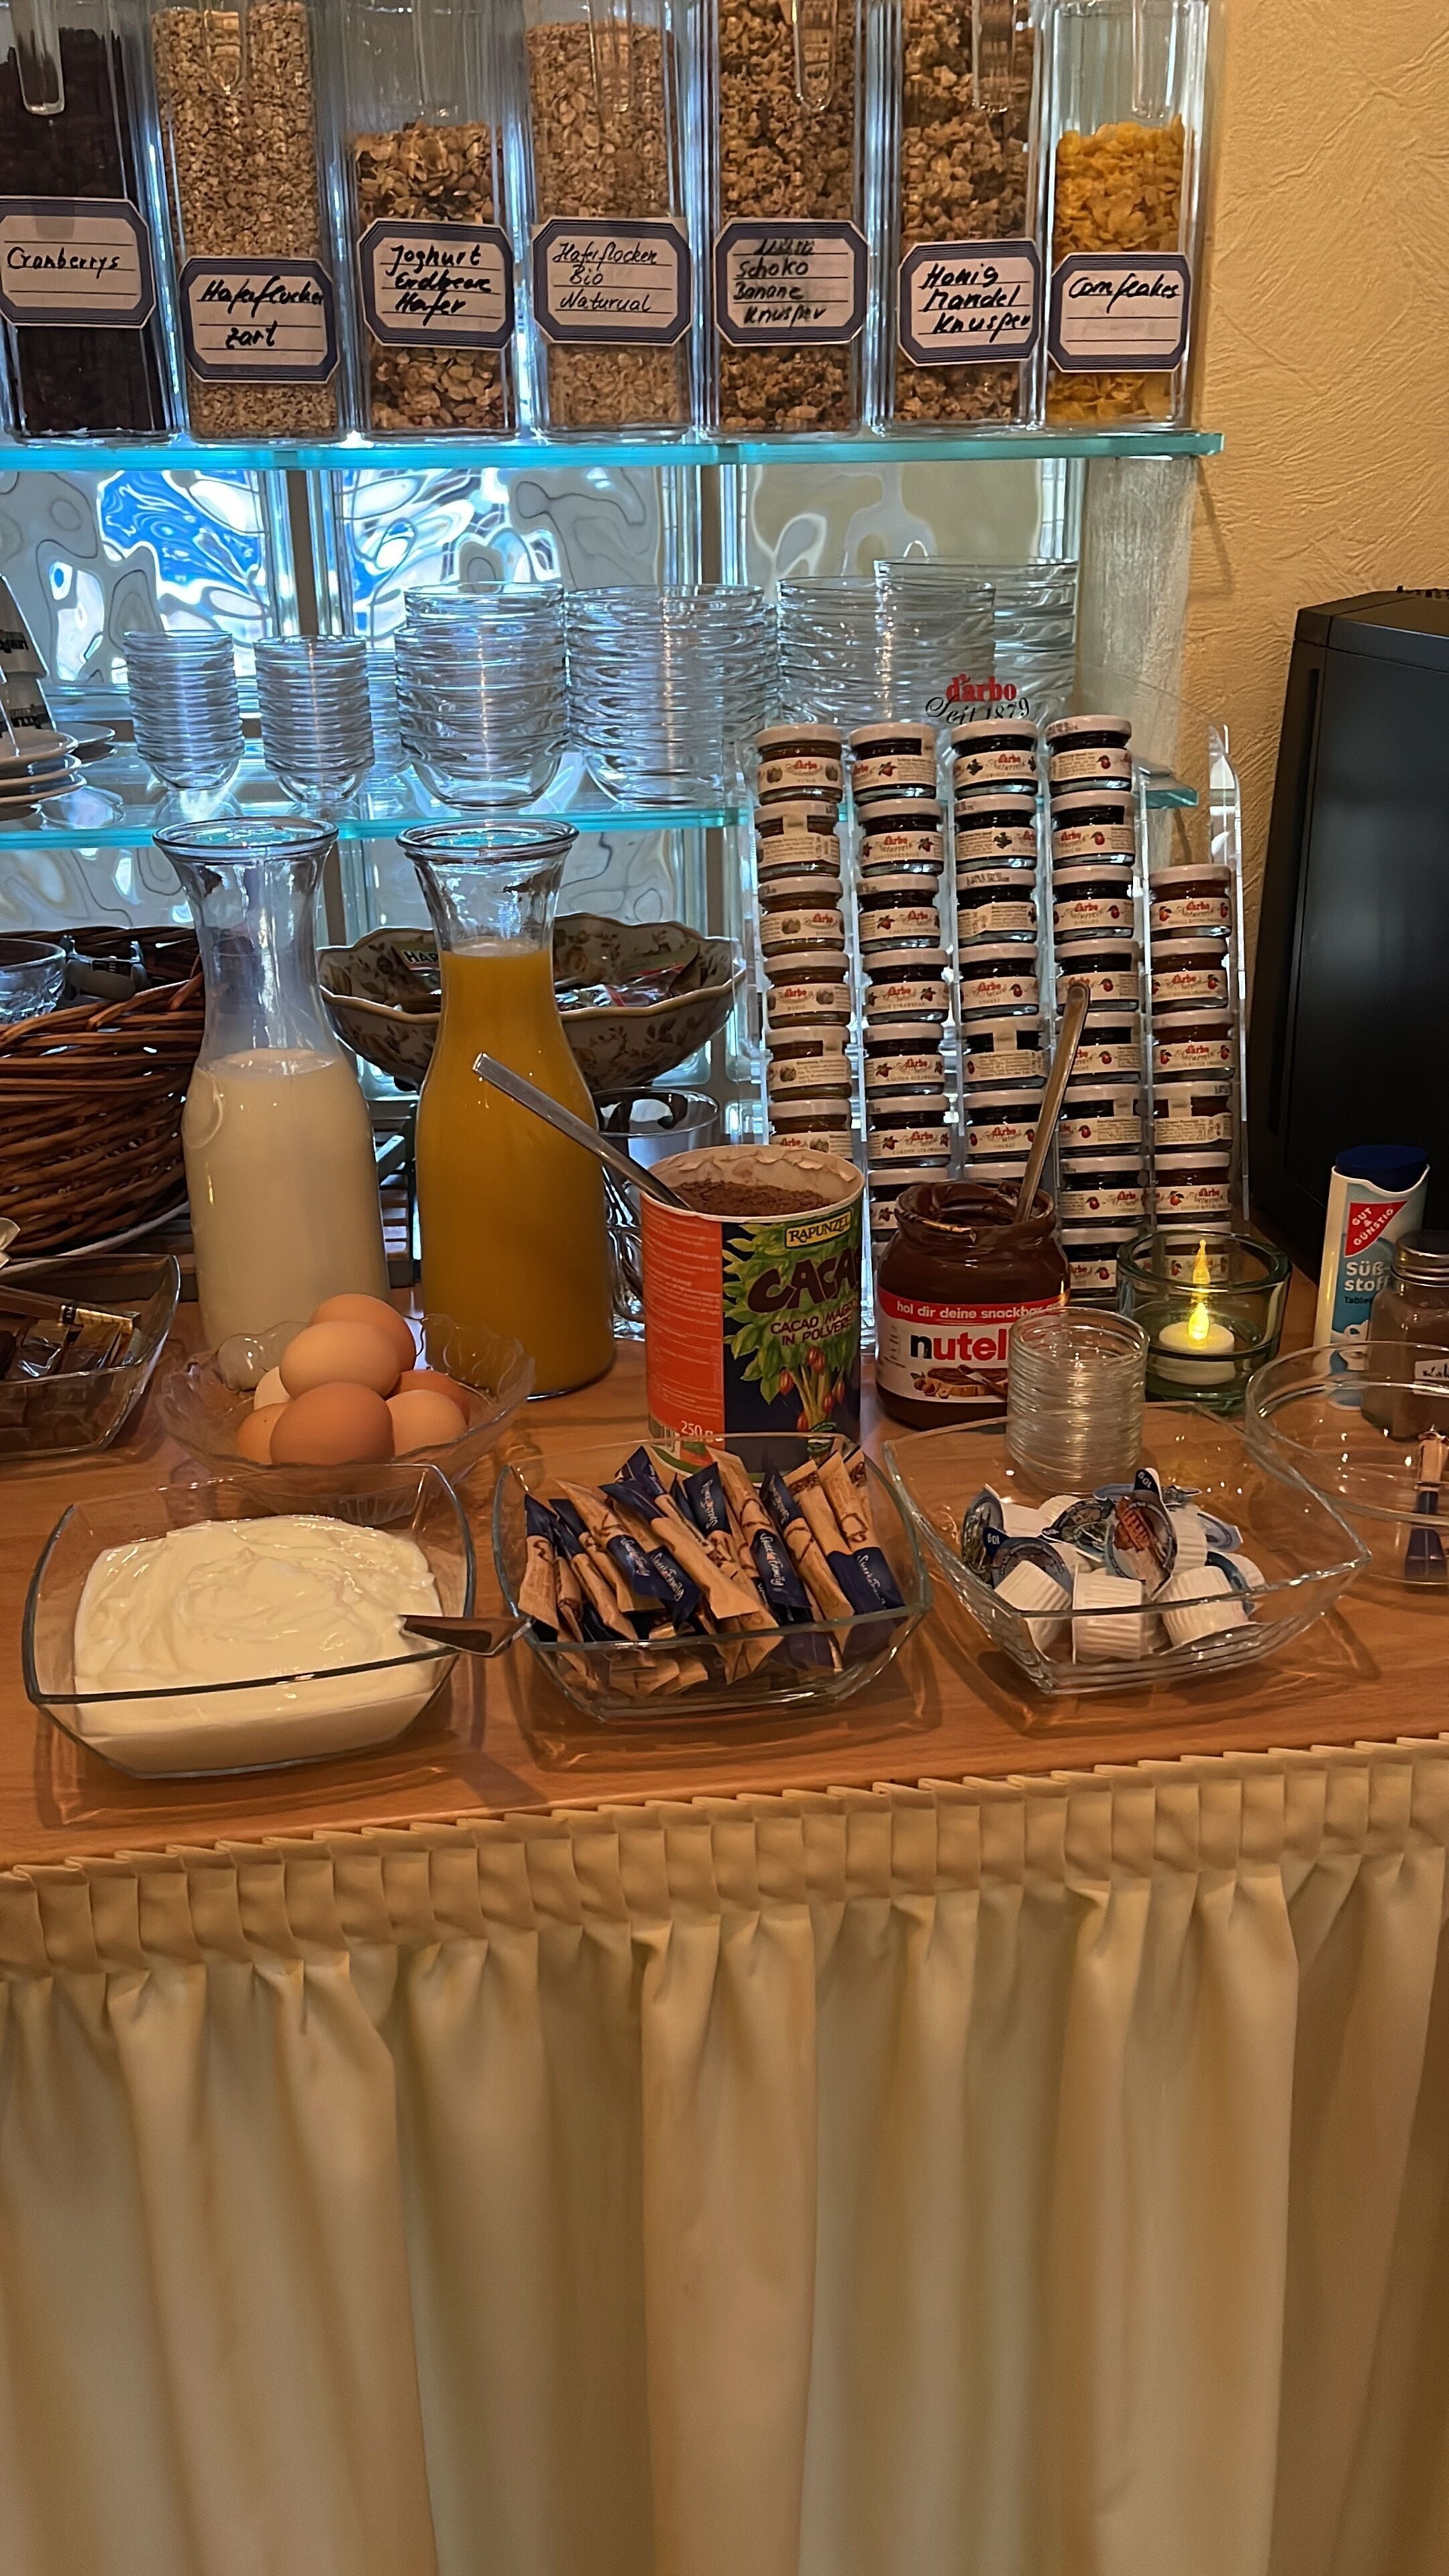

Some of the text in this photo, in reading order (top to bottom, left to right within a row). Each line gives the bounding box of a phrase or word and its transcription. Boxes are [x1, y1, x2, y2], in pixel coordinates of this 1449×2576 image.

[7, 247, 121, 279] Cranberrys
[386, 244, 481, 276] Joghurt
[553, 241, 658, 268] Haferflocken
[736, 256, 808, 278] Schoko
[570, 266, 603, 286] Bio
[922, 263, 998, 289] Honig
[733, 280, 804, 300] Banane
[395, 290, 466, 326] Hafer
[932, 311, 1031, 342] Knusper
[985, 696, 1030, 720] 1879
[403, 950, 439, 963] HAR
[788, 1214, 850, 1243] RAPUNZEL
[1352, 1207, 1372, 1226] GUT
[1353, 1208, 1394, 1246] GÜNSTIG
[1363, 1219, 1374, 1228] &
[897, 1300, 913, 1314] hol
[917, 1307, 936, 1318] dir
[940, 1307, 977, 1319] deine
[1344, 1296, 1373, 1304] Table
[771, 1316, 819, 1334] CACAO
[782, 1315, 853, 1346] IN POLVERE
[910, 1328, 1010, 1361] nutel
